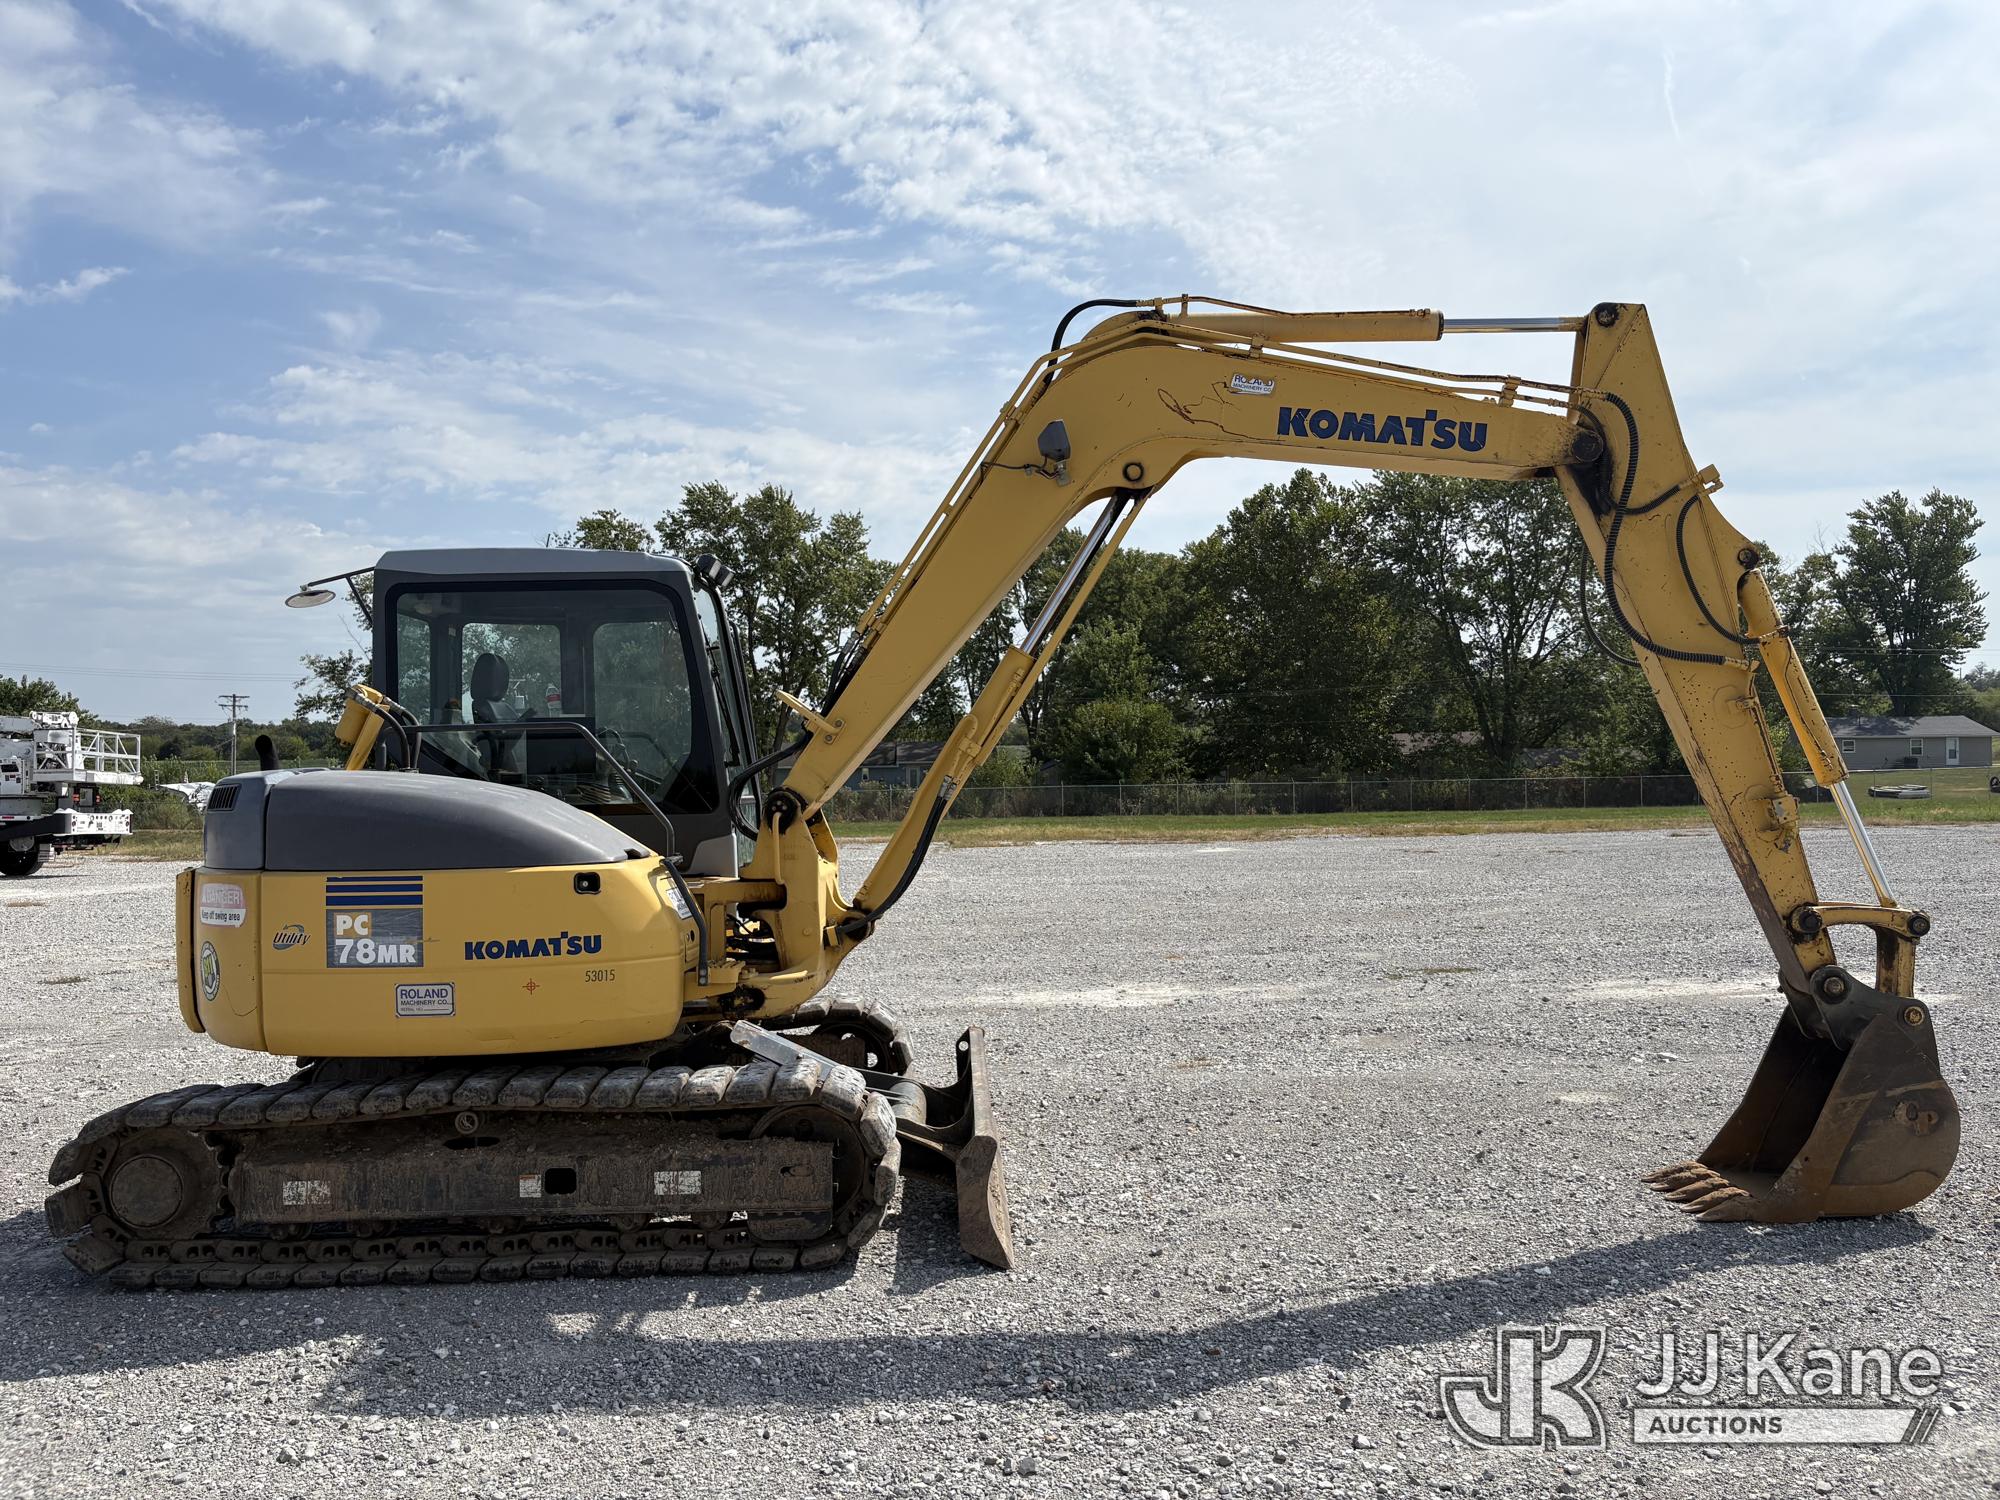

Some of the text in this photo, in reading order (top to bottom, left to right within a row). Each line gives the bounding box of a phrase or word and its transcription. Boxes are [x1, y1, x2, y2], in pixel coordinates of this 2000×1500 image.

[1277, 406, 1488, 452] KOMATSU
[214, 911, 228, 922] swing
[228, 913, 240, 921] area
[335, 914, 369, 936] PC
[273, 932, 311, 945] Utility
[464, 931, 602, 961] KOMATSU
[335, 938, 416, 965] 78MR
[585, 969, 615, 982] 53015
[400, 988, 448, 999] ROLAND
